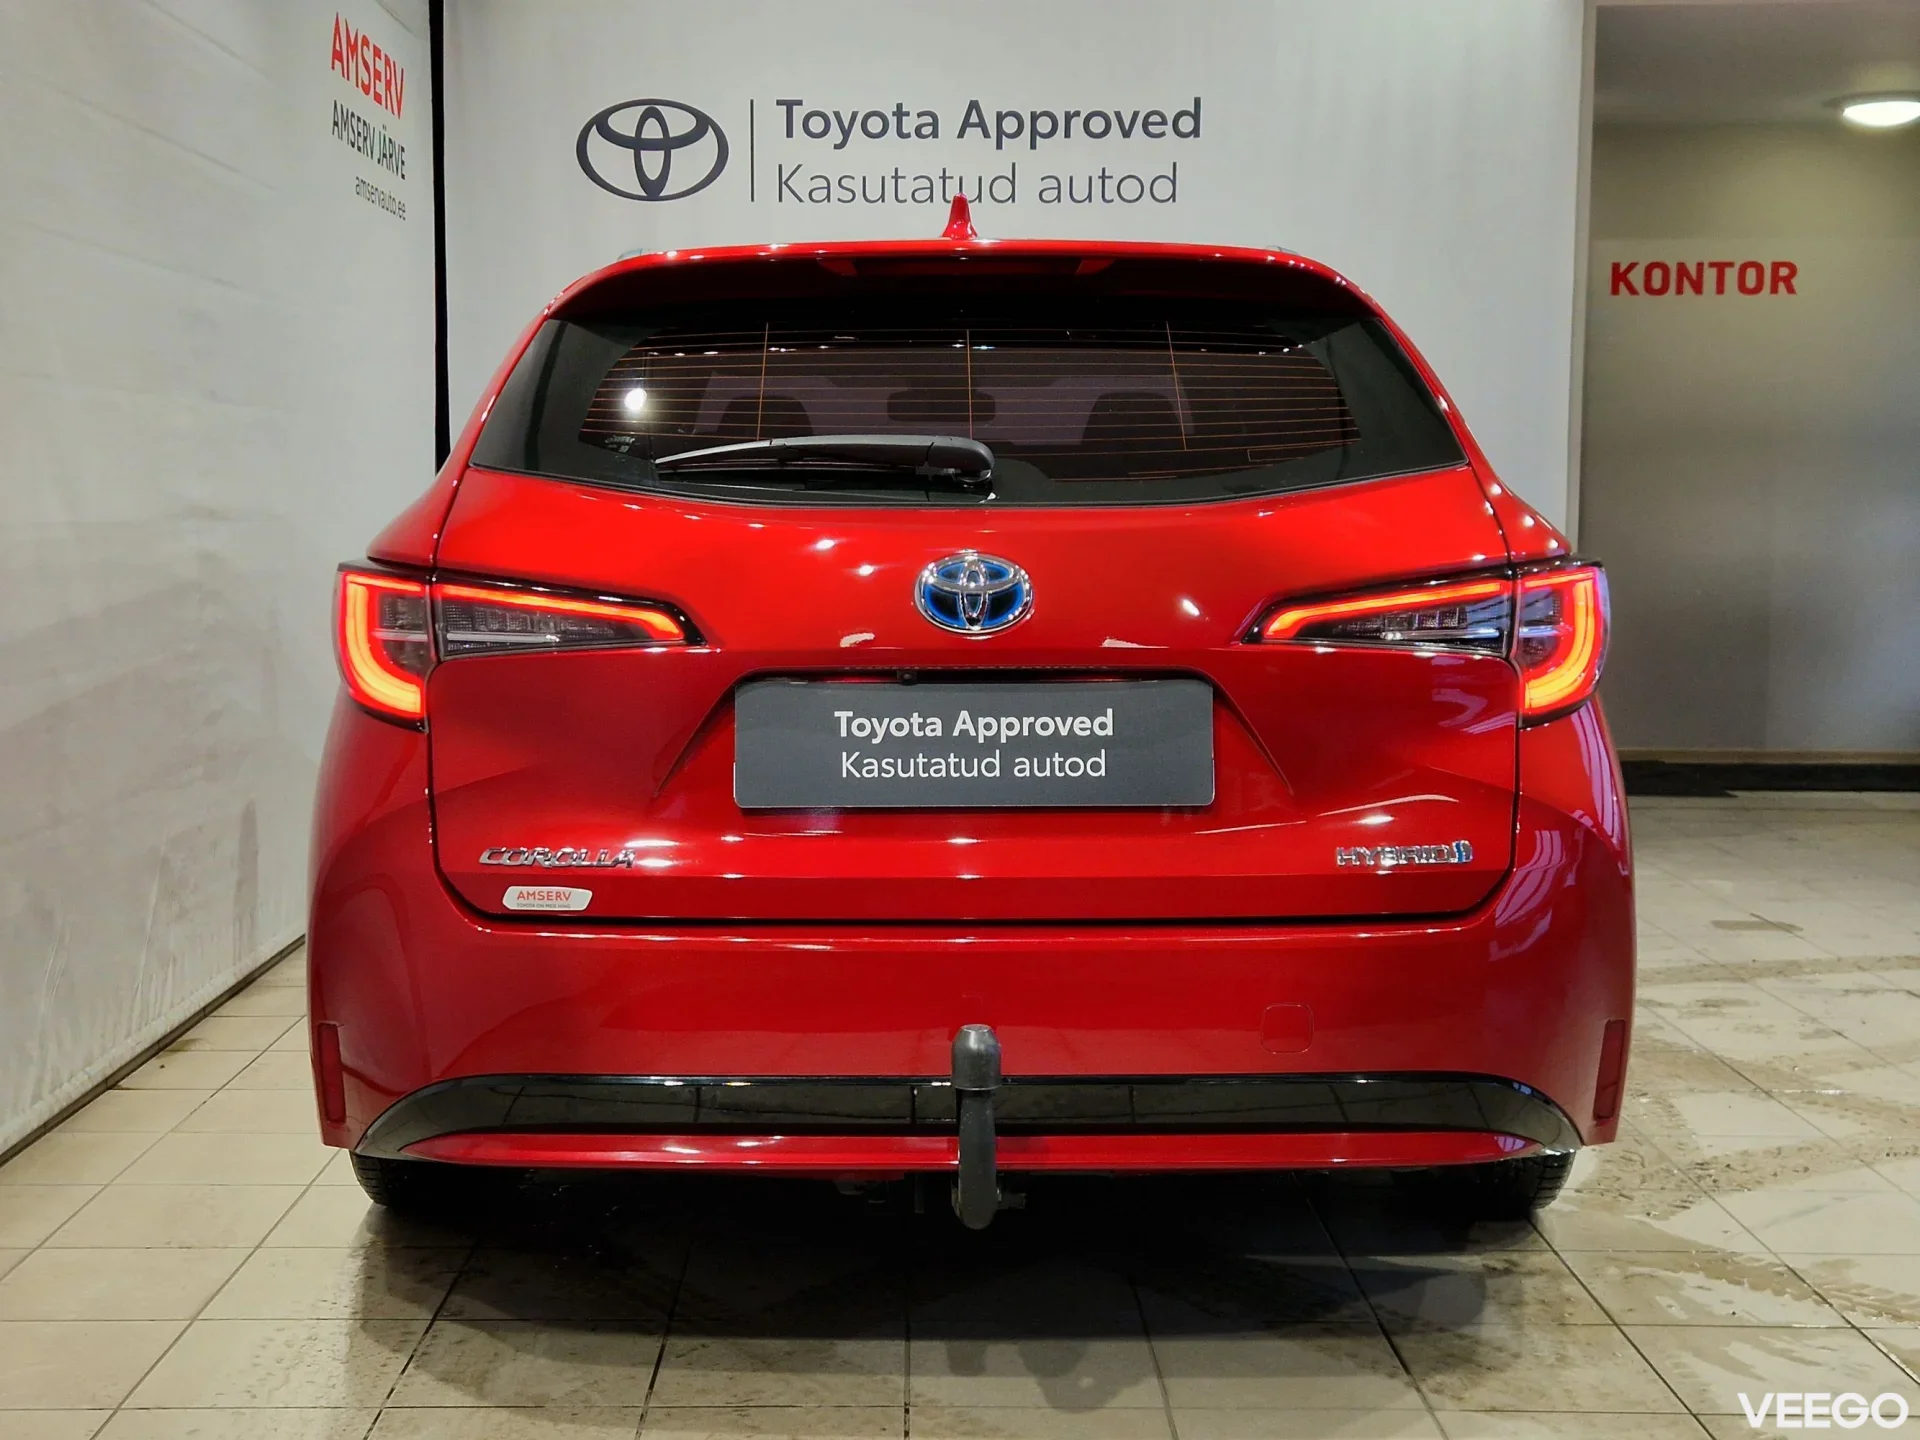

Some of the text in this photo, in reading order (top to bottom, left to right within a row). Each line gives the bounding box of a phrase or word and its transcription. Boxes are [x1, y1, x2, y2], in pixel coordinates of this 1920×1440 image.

[331, 12, 404, 119] AMSERV
[332, 100, 405, 180] AMSERV JÄRVE
[776, 97, 1202, 150] Toyota Approved
[355, 176, 406, 221] amservauto.ee
[778, 162, 1177, 204] Kasutatud autod
[1610, 261, 1798, 296] KONTOR
[834, 708, 1114, 744] Toyota Approved
[841, 749, 1106, 778] Kasutatud autod
[479, 847, 636, 868] COROLLA
[1336, 844, 1451, 866] HYBRID
[516, 890, 572, 901] AMSERV
